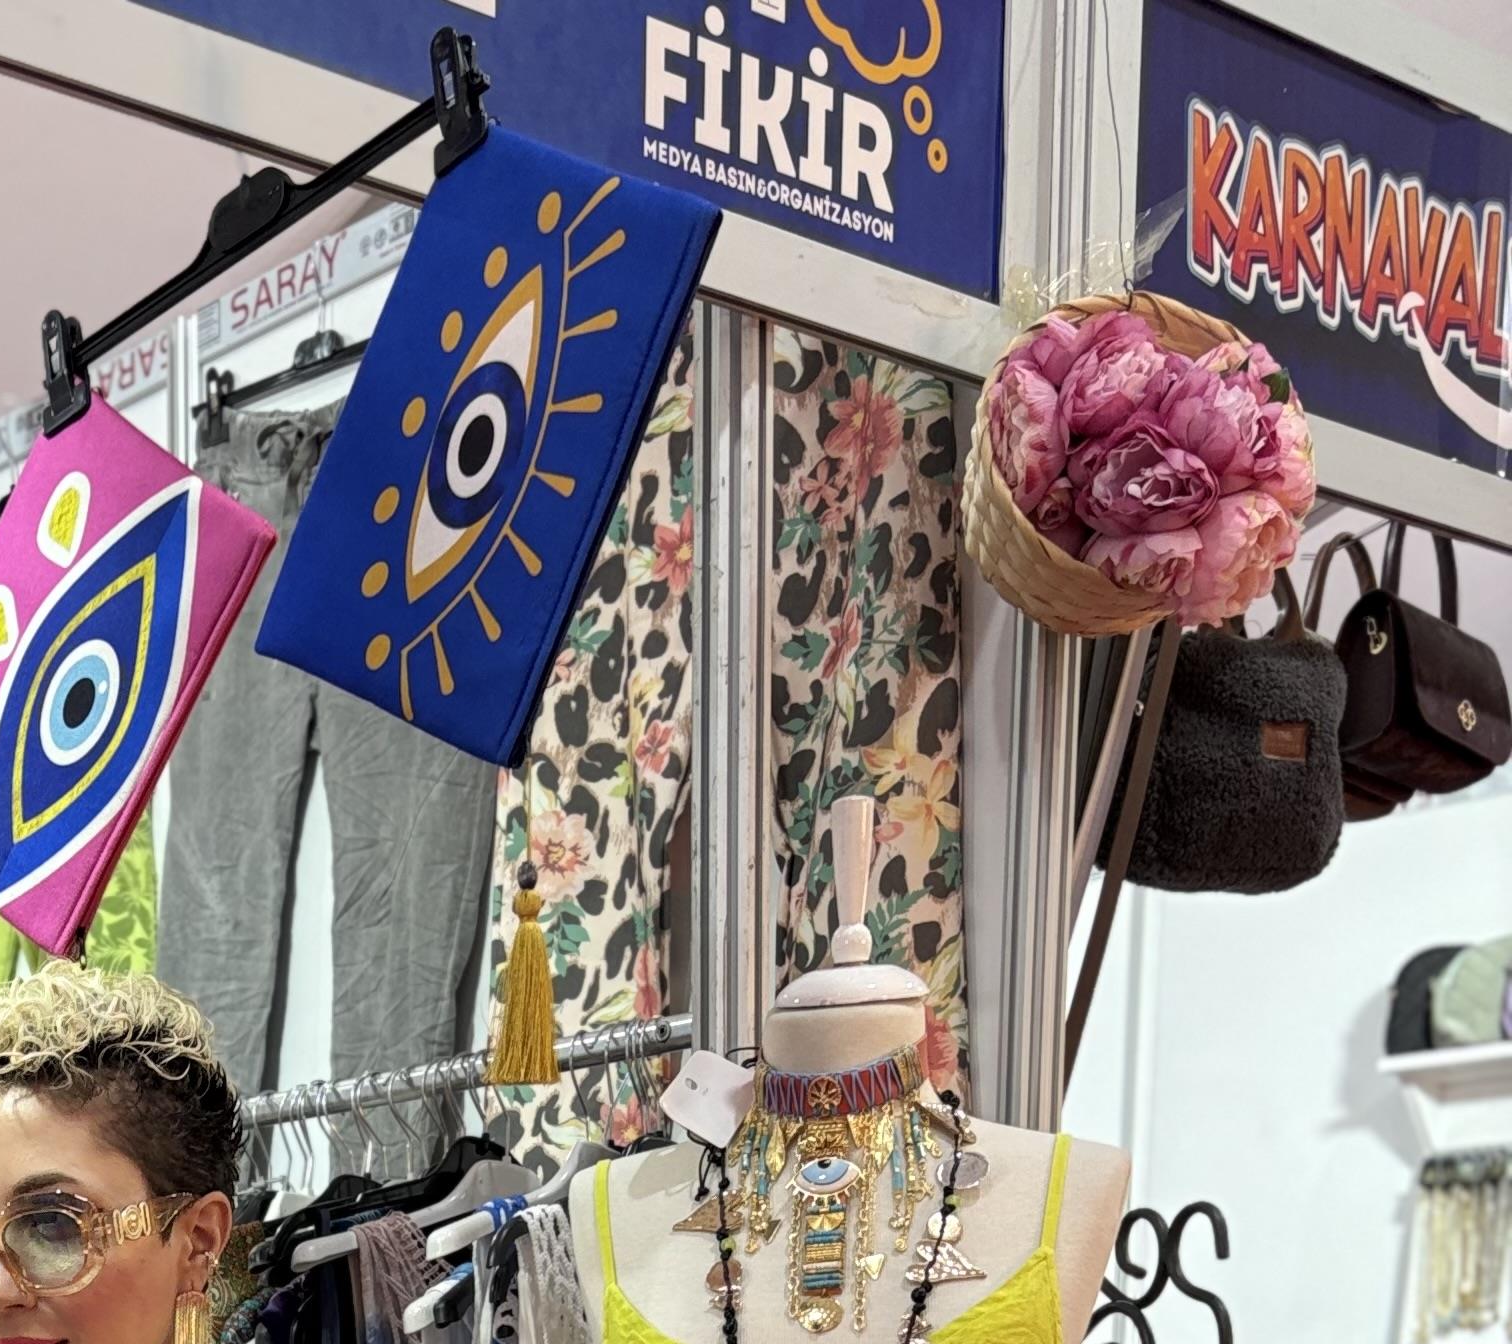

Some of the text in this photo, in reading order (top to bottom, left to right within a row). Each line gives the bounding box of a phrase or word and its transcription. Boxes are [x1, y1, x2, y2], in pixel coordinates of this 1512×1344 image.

[644, 4, 894, 214] FİKİR
[642, 136, 703, 177] MEDYA
[230, 236, 342, 331] SARAY
[97, 336, 169, 399] ARA
